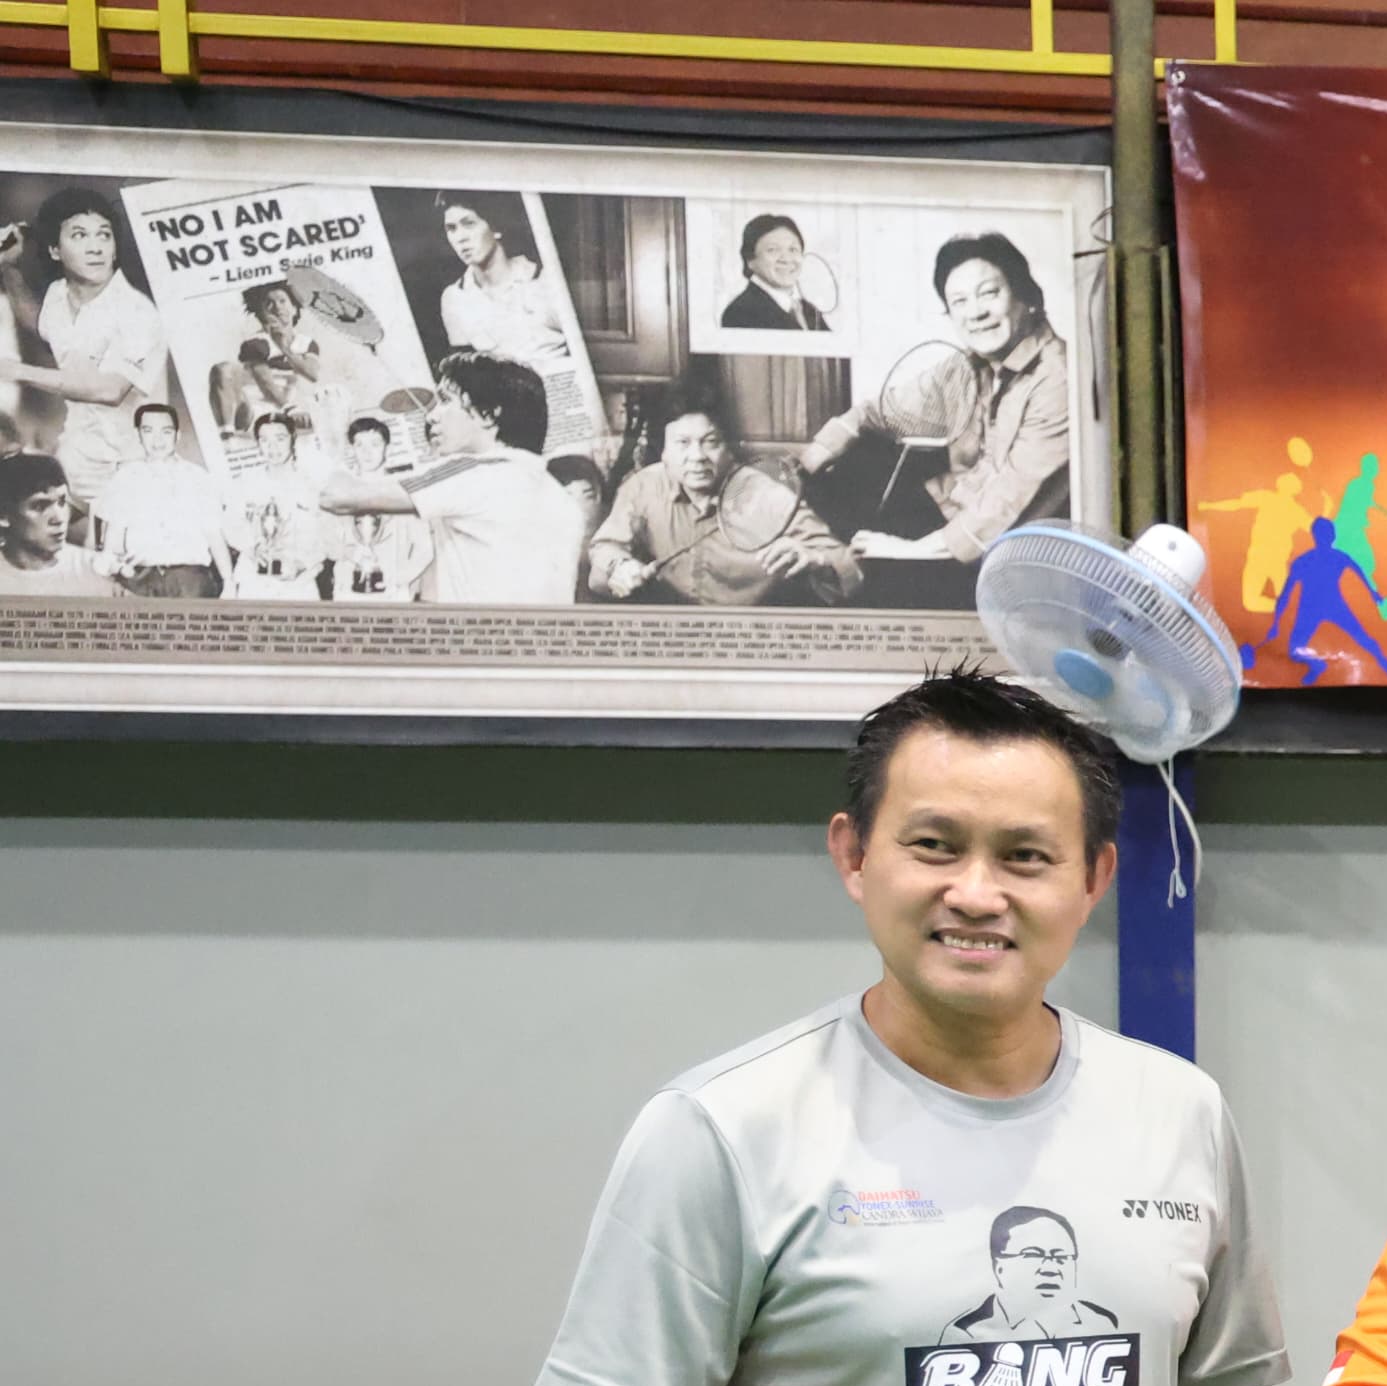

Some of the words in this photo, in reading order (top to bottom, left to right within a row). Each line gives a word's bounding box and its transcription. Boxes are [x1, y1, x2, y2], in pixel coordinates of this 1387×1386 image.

[212, 210, 224, 232] I
[235, 199, 282, 228] AM
[166, 239, 229, 271] NOT
[226, 263, 272, 283] Liem
[330, 245, 373, 264] King
[858, 1189, 920, 1201] DAIHATSU
[1153, 1200, 1202, 1223] YONEX
